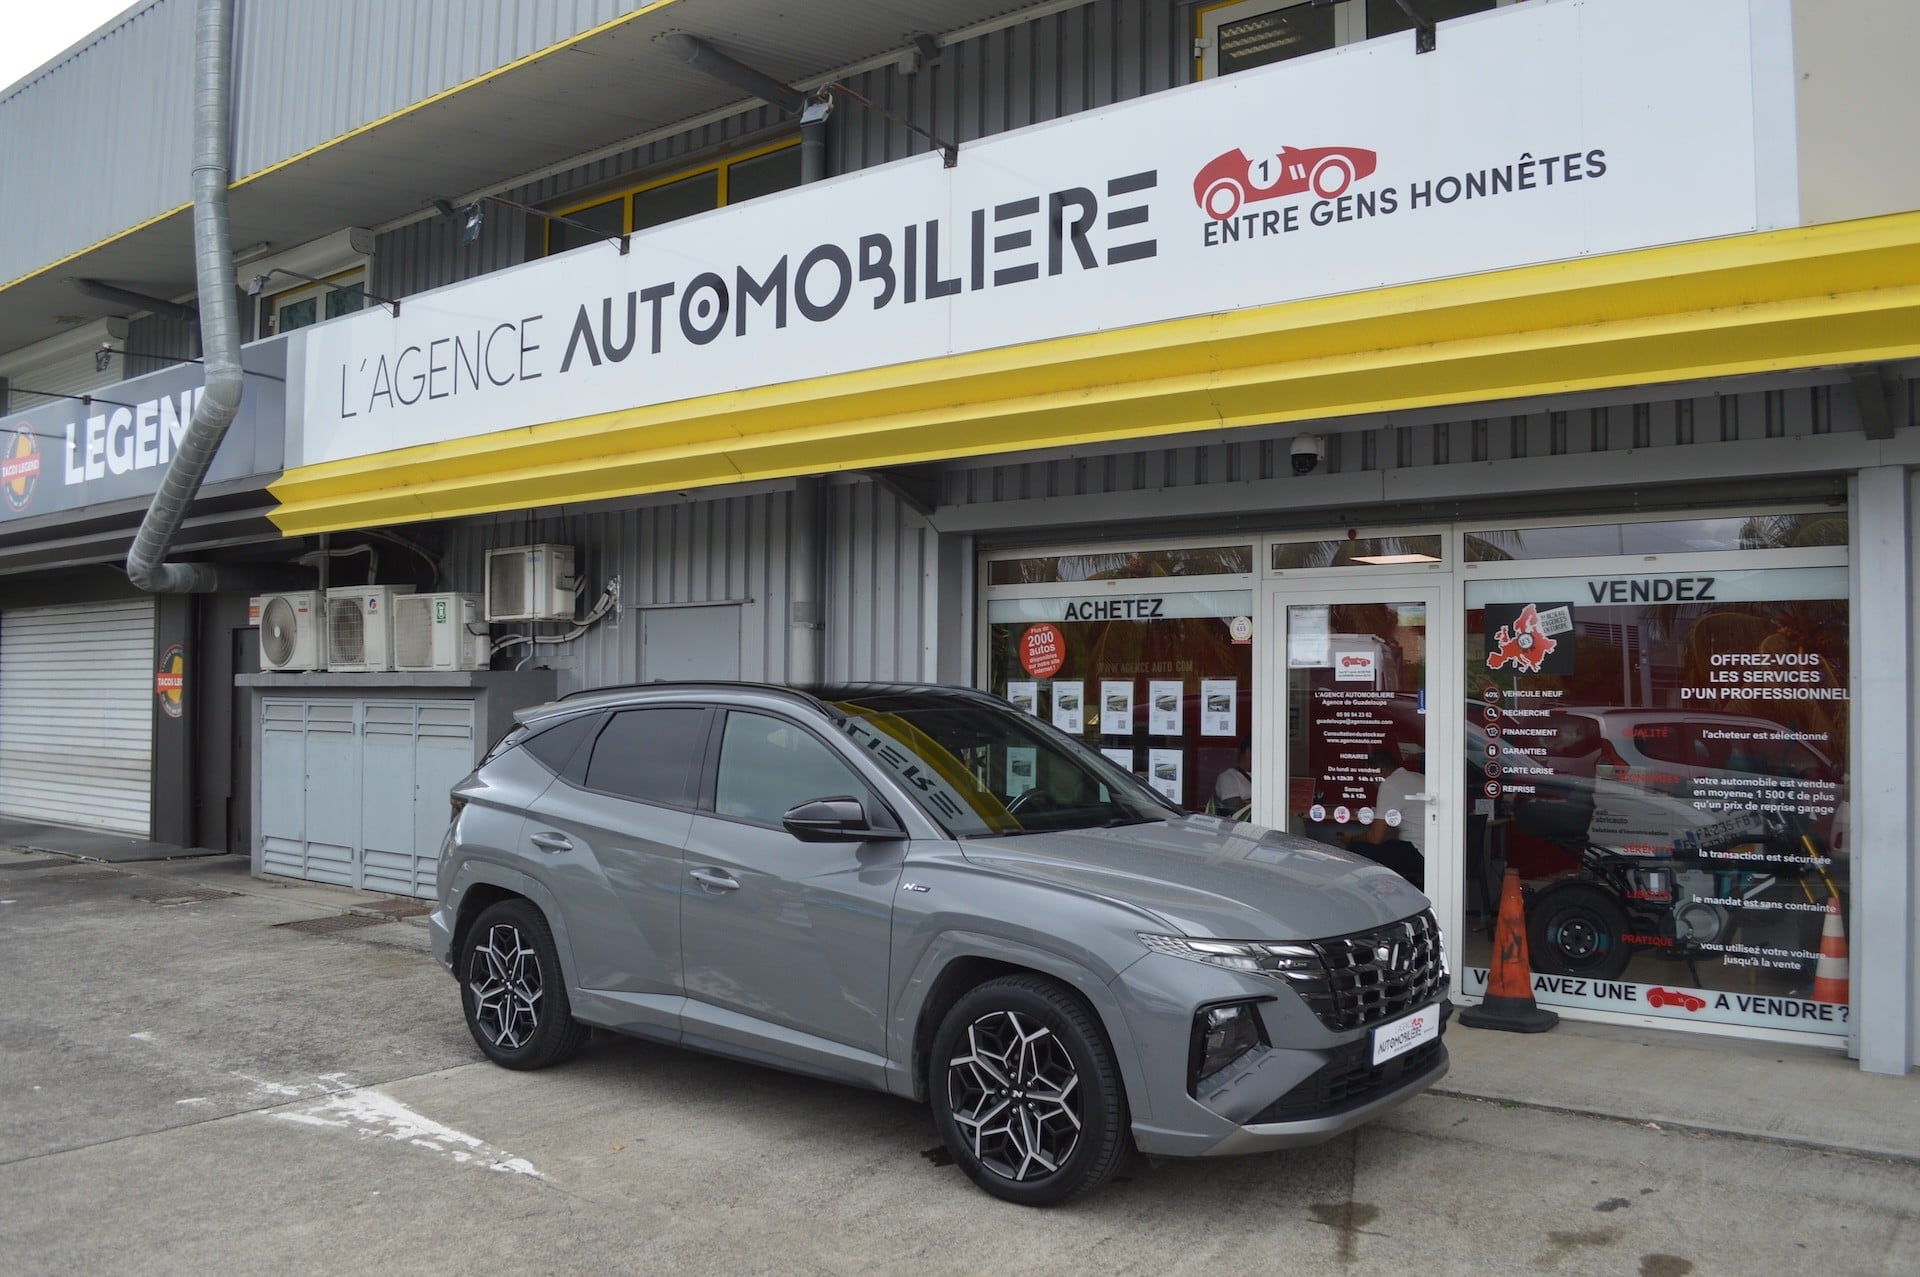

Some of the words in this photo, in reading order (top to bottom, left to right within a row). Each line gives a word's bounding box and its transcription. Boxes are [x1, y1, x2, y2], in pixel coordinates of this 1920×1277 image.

[1257, 160, 1269, 182] 1
[1204, 205, 1299, 247] ENTRE
[1310, 187, 1398, 227] GENS
[1410, 149, 1607, 210] HONNÊTES
[341, 315, 543, 418] L'AGENCE
[559, 169, 1158, 373] AUTOMOBILIERE
[65, 386, 206, 485] LEGEN
[1588, 578, 1716, 603] VENDEZ
[1064, 599, 1164, 620] ACHETEZ
[1028, 631, 1054, 648] 2000
[1029, 644, 1056, 656] autos
[1710, 654, 1819, 666] OFFREZ-VOUS
[1710, 671, 1738, 682] LES
[1743, 670, 1820, 682] SERVICES
[1720, 688, 1850, 700] PROFESSIONNEL
[1702, 730, 1750, 740] l'acheteur
[1752, 732, 1768, 740] est
[1770, 730, 1828, 741] sélectionné
[1693, 778, 1718, 786] votre
[1720, 777, 1778, 787] automobile
[1780, 780, 1795, 788] est
[1797, 780, 1836, 789] vendue
[1708, 790, 1753, 800] moyenne
[1756, 790, 1762, 798] 1
[1764, 790, 1784, 800] 500
[1787, 790, 1794, 800] €
[1796, 790, 1810, 801] de
[1812, 792, 1835, 804] plus
[1693, 801, 1720, 810] qu'un
[1724, 801, 1743, 810] prix
[1745, 802, 1758, 810] de
[1760, 802, 1796, 813] reprise
[1797, 805, 1834, 814] garage
[1699, 849, 1708, 858] la
[1710, 850, 1764, 861] transaction
[1766, 853, 1781, 862] est
[1784, 854, 1832, 864] sécurisée
[1692, 894, 1703, 904] le
[1704, 896, 1742, 906] mandat
[1744, 898, 1758, 908] est
[1760, 901, 1782, 910] sans
[1784, 902, 1836, 913] contrainte
[1621, 934, 1674, 946] PRATIQUE
[1726, 943, 1760, 954] utilisez
[1762, 947, 1788, 956] votre
[1790, 948, 1826, 960] voiture
[1724, 955, 1759, 966] jusqu'à
[1761, 957, 1770, 966] la
[1772, 960, 1801, 970] vente
[1534, 976, 1586, 996] AVEZ
[1593, 983, 1636, 1001] UNE
[1714, 994, 1730, 1010] A
[1736, 996, 1834, 1021] VENDRE
[1837, 1006, 1848, 1022] ?
